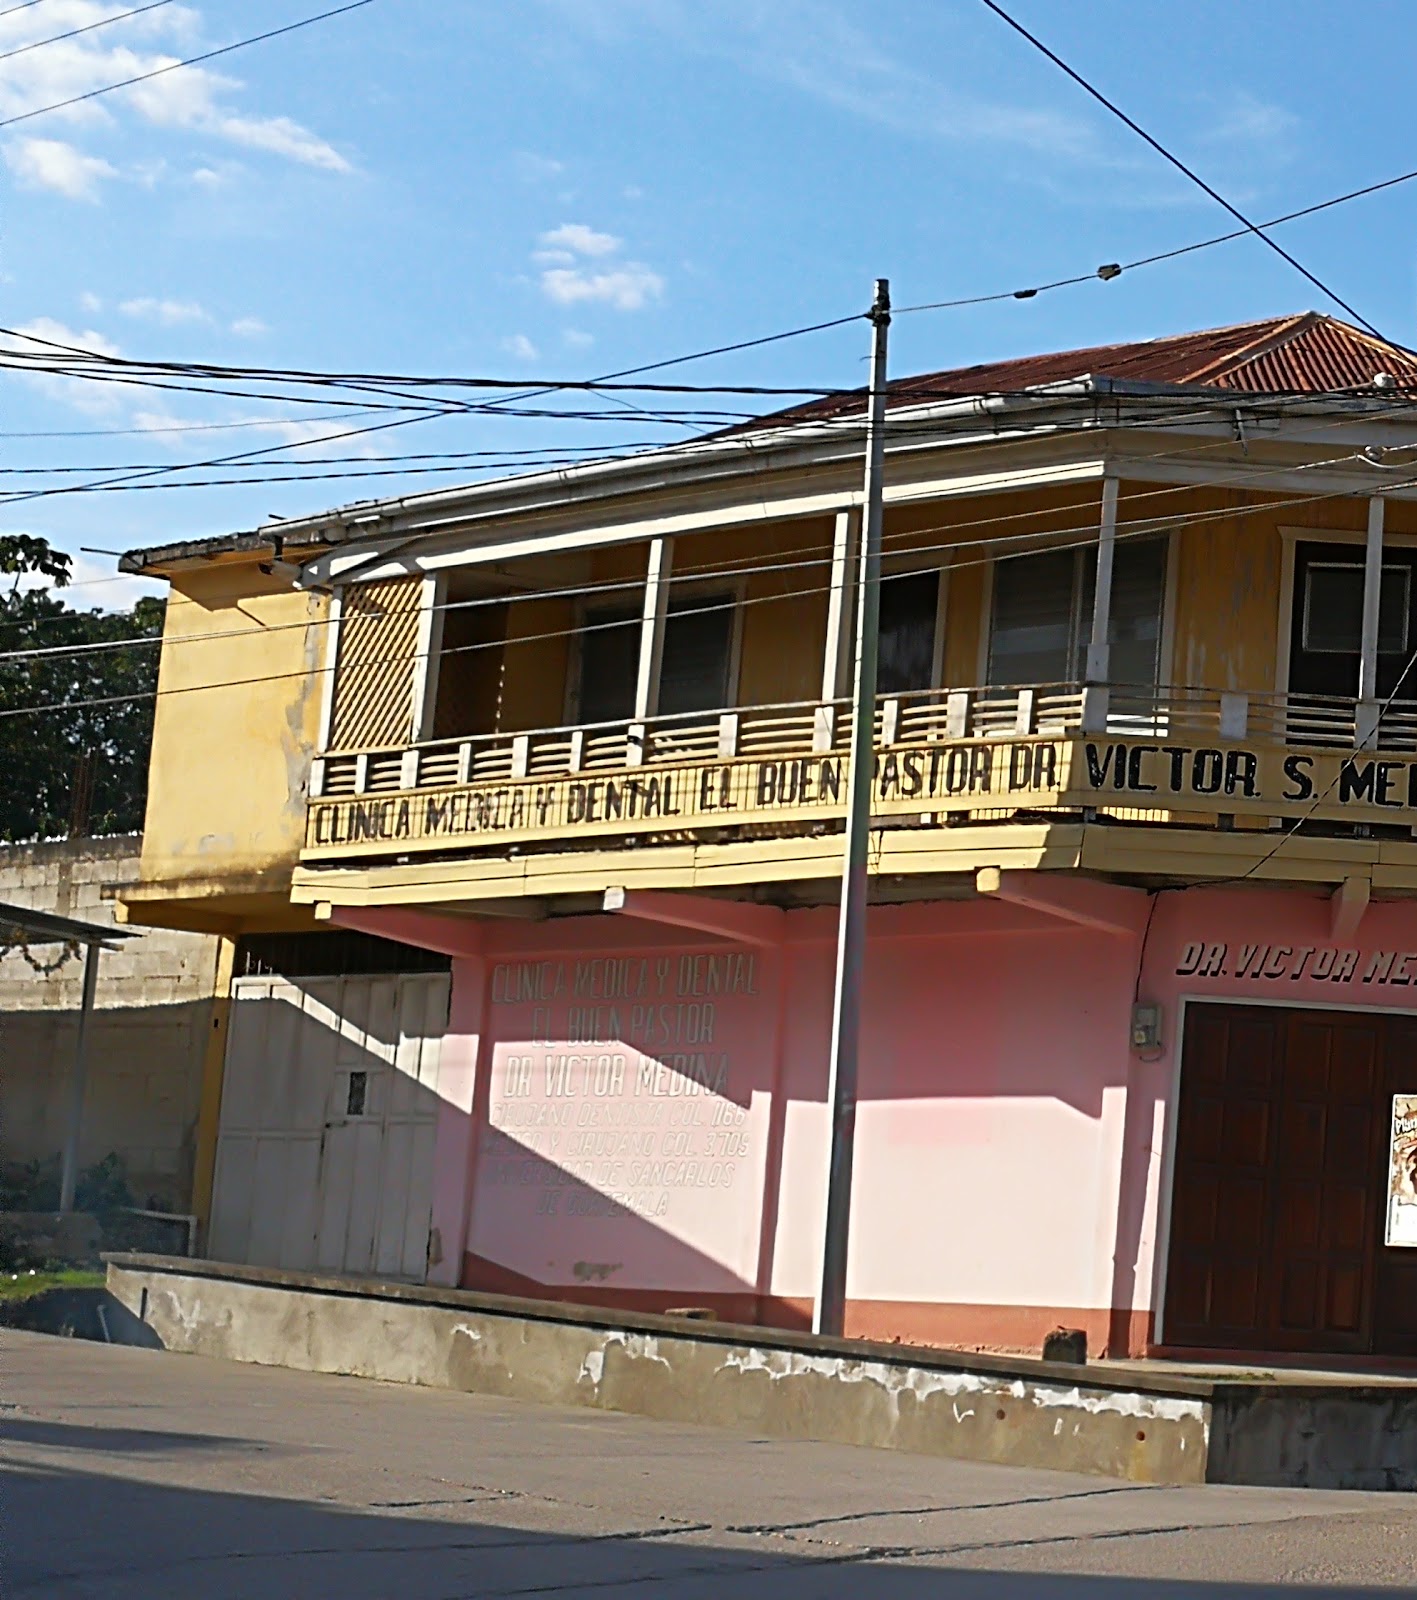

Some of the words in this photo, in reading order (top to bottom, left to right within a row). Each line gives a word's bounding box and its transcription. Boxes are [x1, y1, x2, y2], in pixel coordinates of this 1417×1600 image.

[316, 799, 410, 844] CLINICA
[537, 786, 556, 826] Y
[568, 775, 680, 825] DENTAL
[701, 766, 737, 810] EL
[757, 757, 840, 806] BUEN
[1009, 743, 1061, 794] DR.
[1283, 755, 1318, 801] S.
[491, 959, 567, 1005] CLINICA
[575, 956, 652, 1001] MEDICA
[656, 956, 670, 997] Y
[678, 952, 760, 998] DENTAL
[1176, 942, 1228, 977] DR.
[1235, 944, 1360, 983] VICTOR
[532, 1006, 556, 1049] EL
[568, 1004, 623, 1048] BUEN
[630, 1002, 715, 1046] PASTOR
[503, 1055, 534, 1099] DR
[545, 1053, 627, 1098] VICTOR
[634, 1052, 729, 1099] MEDINA
[493, 1101, 573, 1127] CIRUJANO
[577, 1101, 664, 1127] DENTISTA
[711, 1100, 746, 1127] 1166
[550, 1130, 561, 1156] Y
[567, 1130, 657, 1157] CIRUJANO
